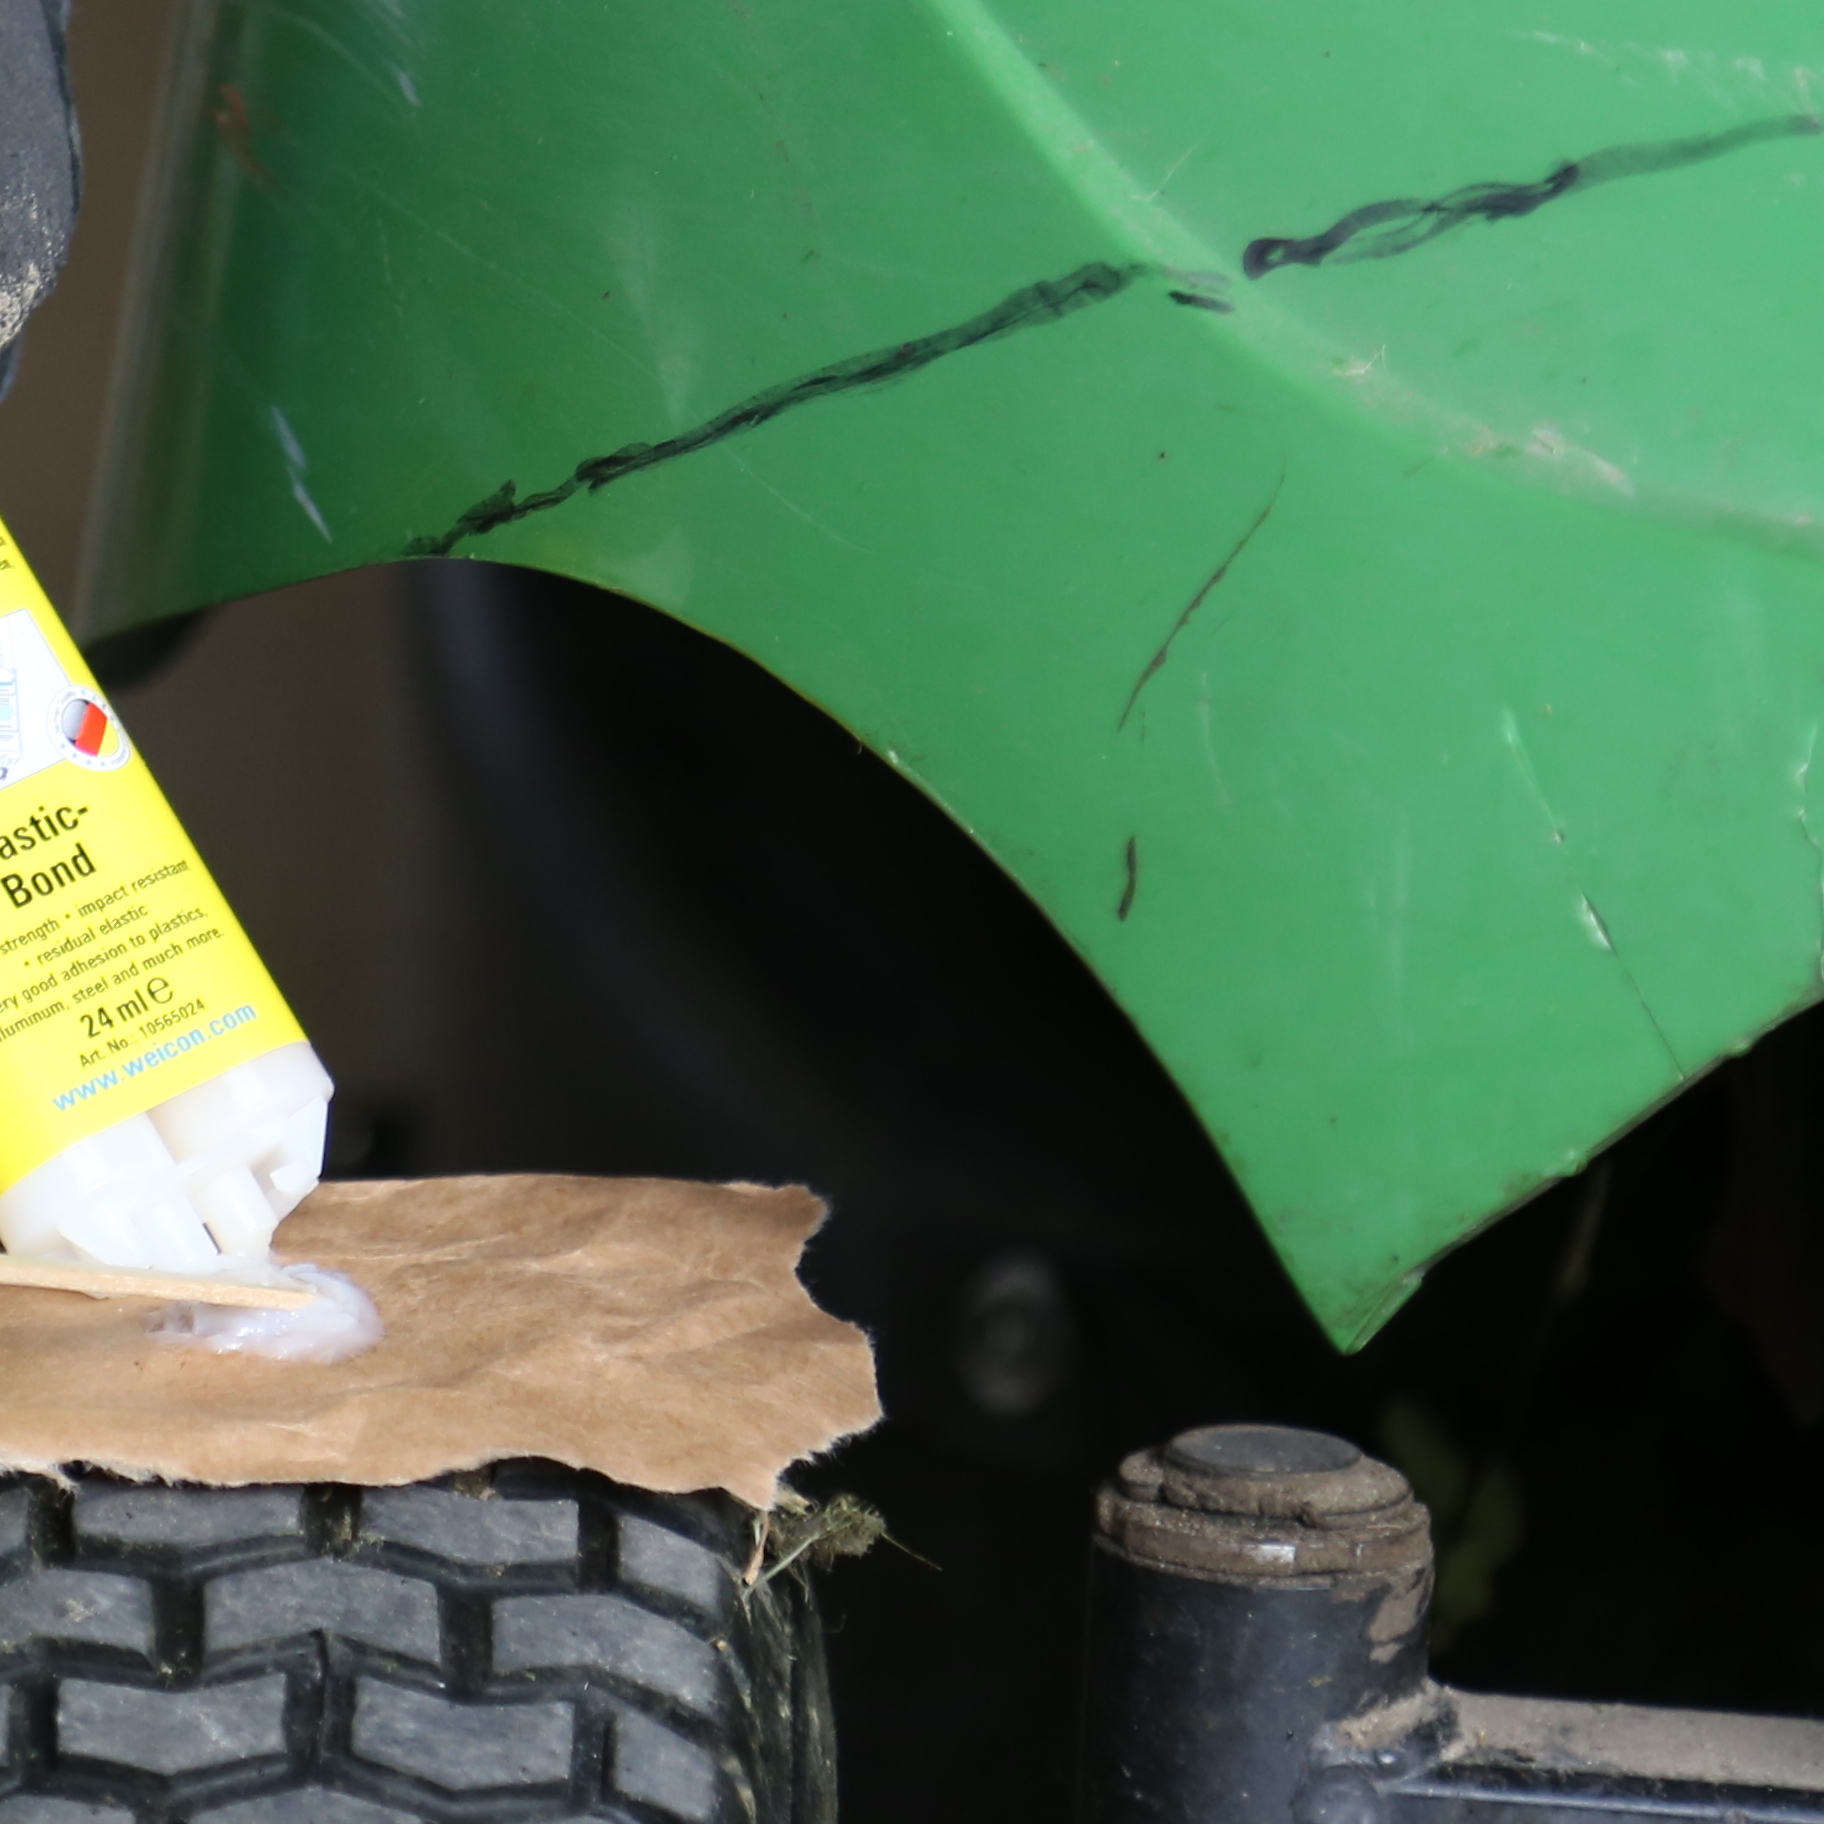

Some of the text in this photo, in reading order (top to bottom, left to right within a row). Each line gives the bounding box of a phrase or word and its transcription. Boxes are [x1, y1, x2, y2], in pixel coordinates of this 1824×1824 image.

[0, 843, 96, 908] Bond
[0, 919, 59, 954] strength
[78, 886, 128, 917] impact
[131, 860, 189, 891] resistant
[37, 906, 147, 964] residual elastic
[22, 974, 58, 1002] good
[62, 944, 127, 980] adhesion
[129, 935, 146, 947] to
[73, 978, 108, 1003] steel
[113, 963, 139, 984] and
[142, 944, 183, 969] much
[80, 1007, 113, 1038] 24
[117, 990, 148, 1021] ml
[139, 999, 205, 1036] 10565024
[53, 1004, 258, 1110] www.weicon.com
